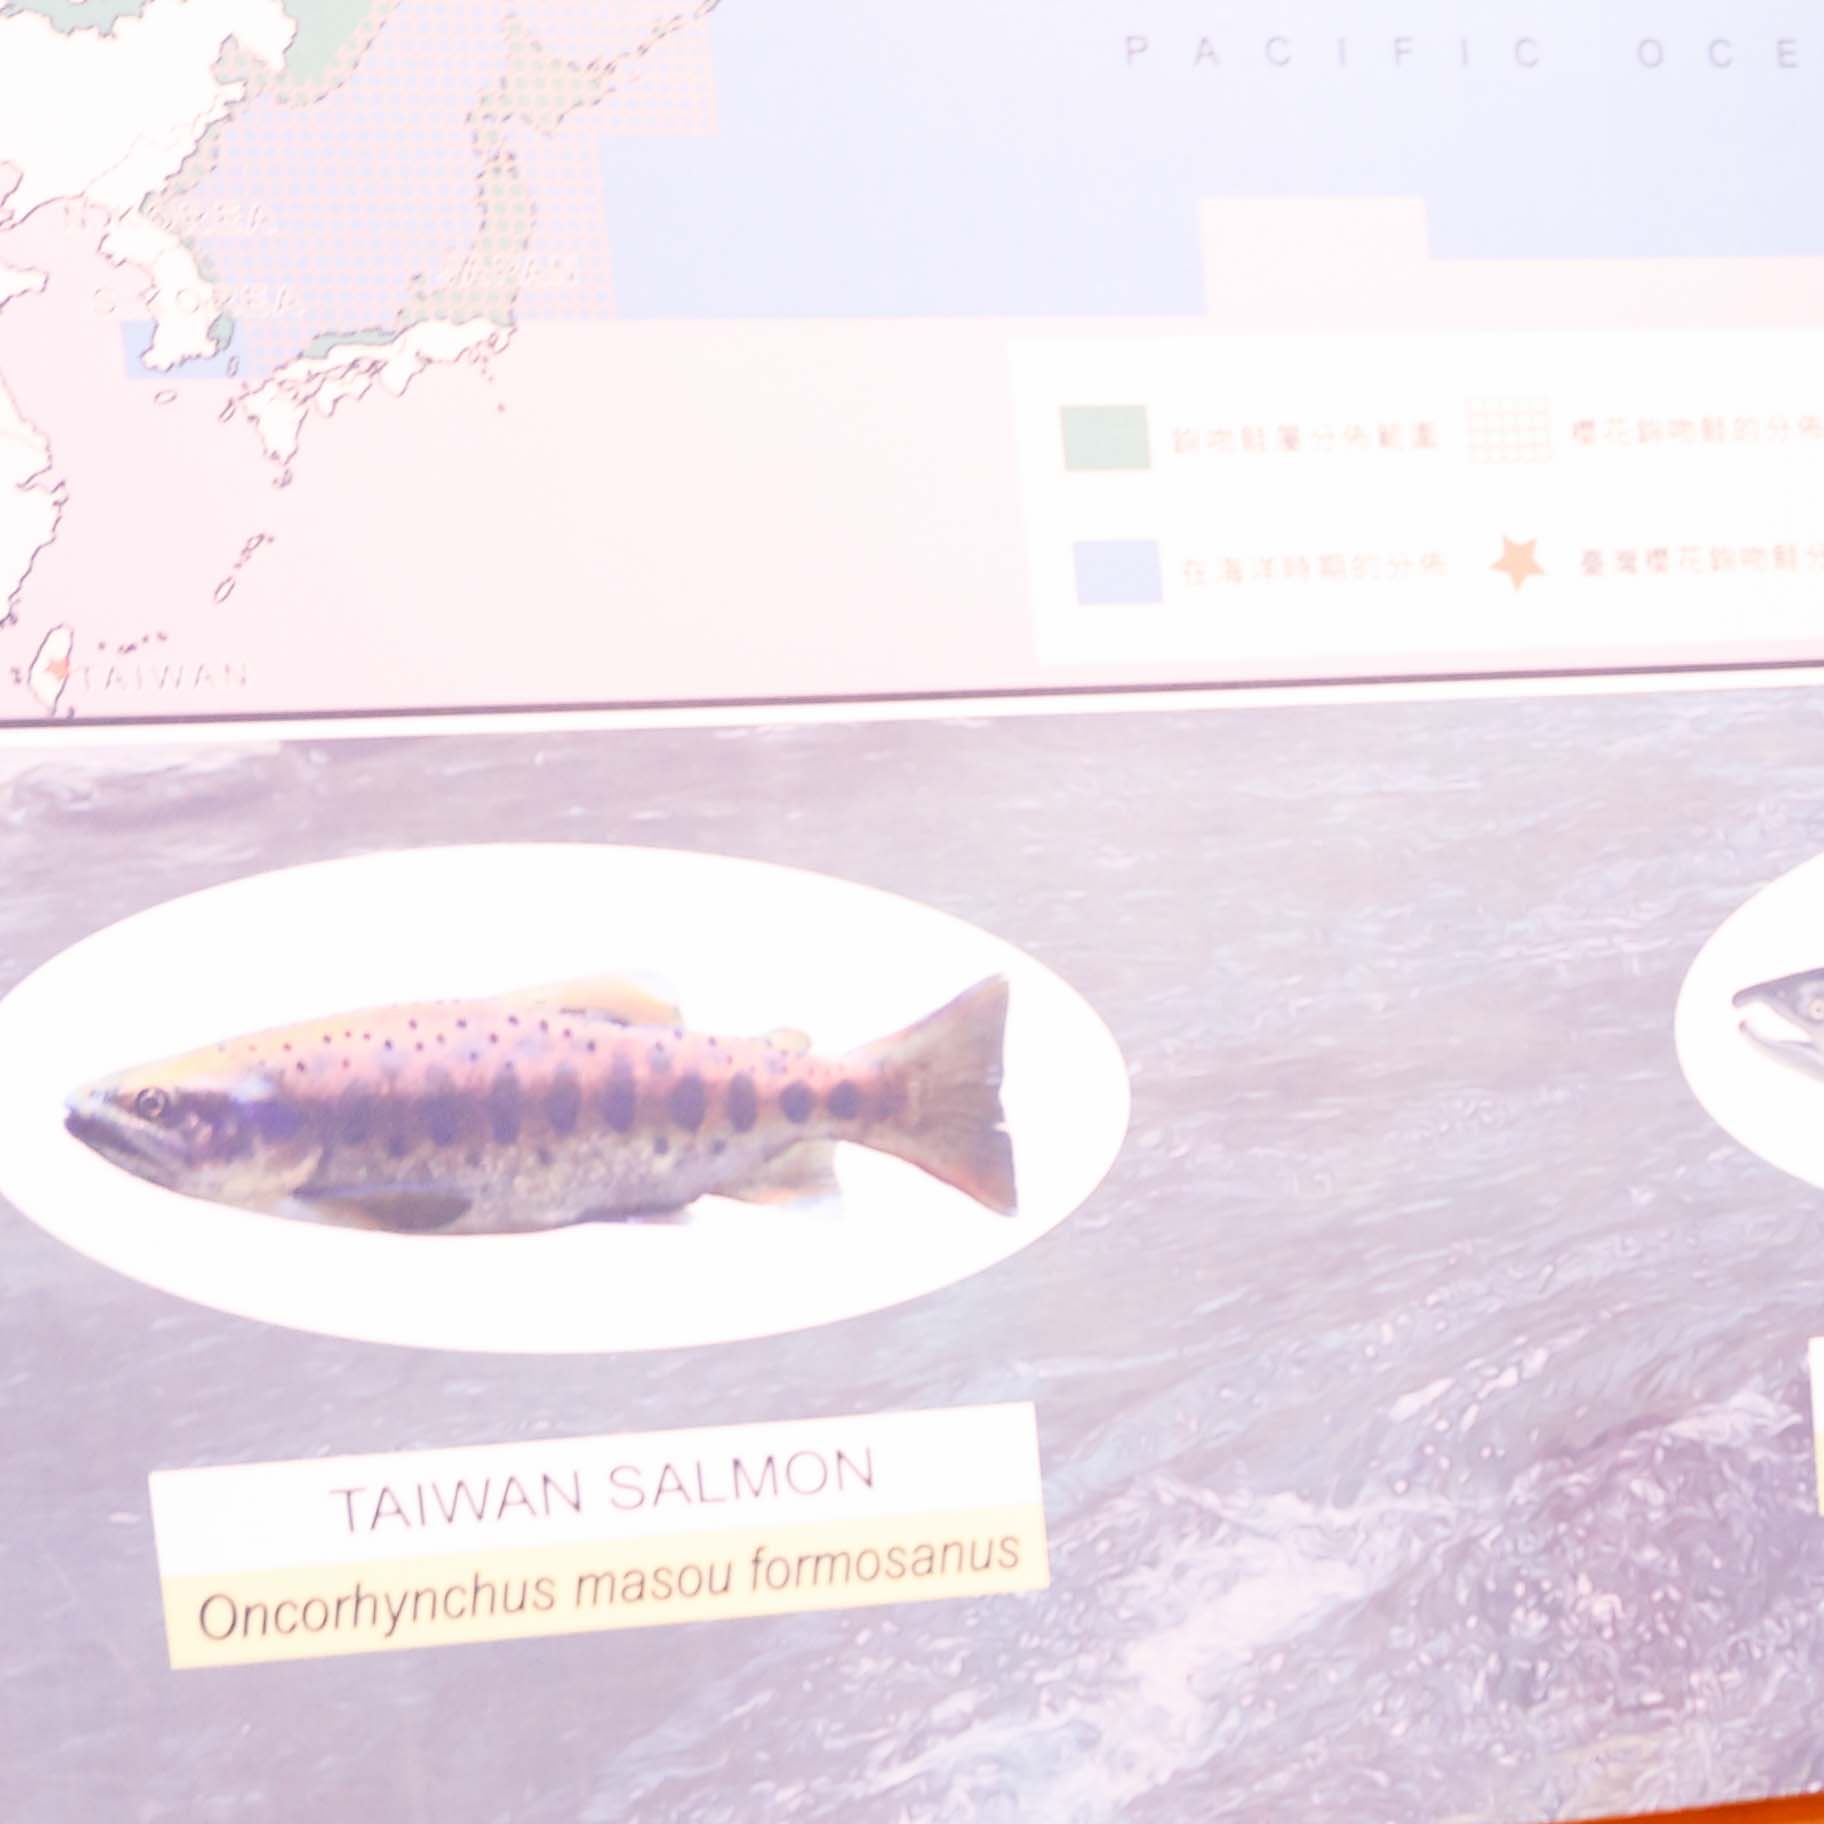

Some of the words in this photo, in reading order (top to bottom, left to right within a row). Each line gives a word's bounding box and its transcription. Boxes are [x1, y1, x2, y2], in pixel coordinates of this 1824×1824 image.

[1125, 34, 1541, 69] PACIFIC
[331, 1469, 583, 1536] TAIWAN
[608, 1445, 875, 1511] SALMON
[198, 1570, 556, 1643] Oncorhynchus
[575, 1555, 732, 1606] masou
[747, 1531, 1022, 1594] formosanus
